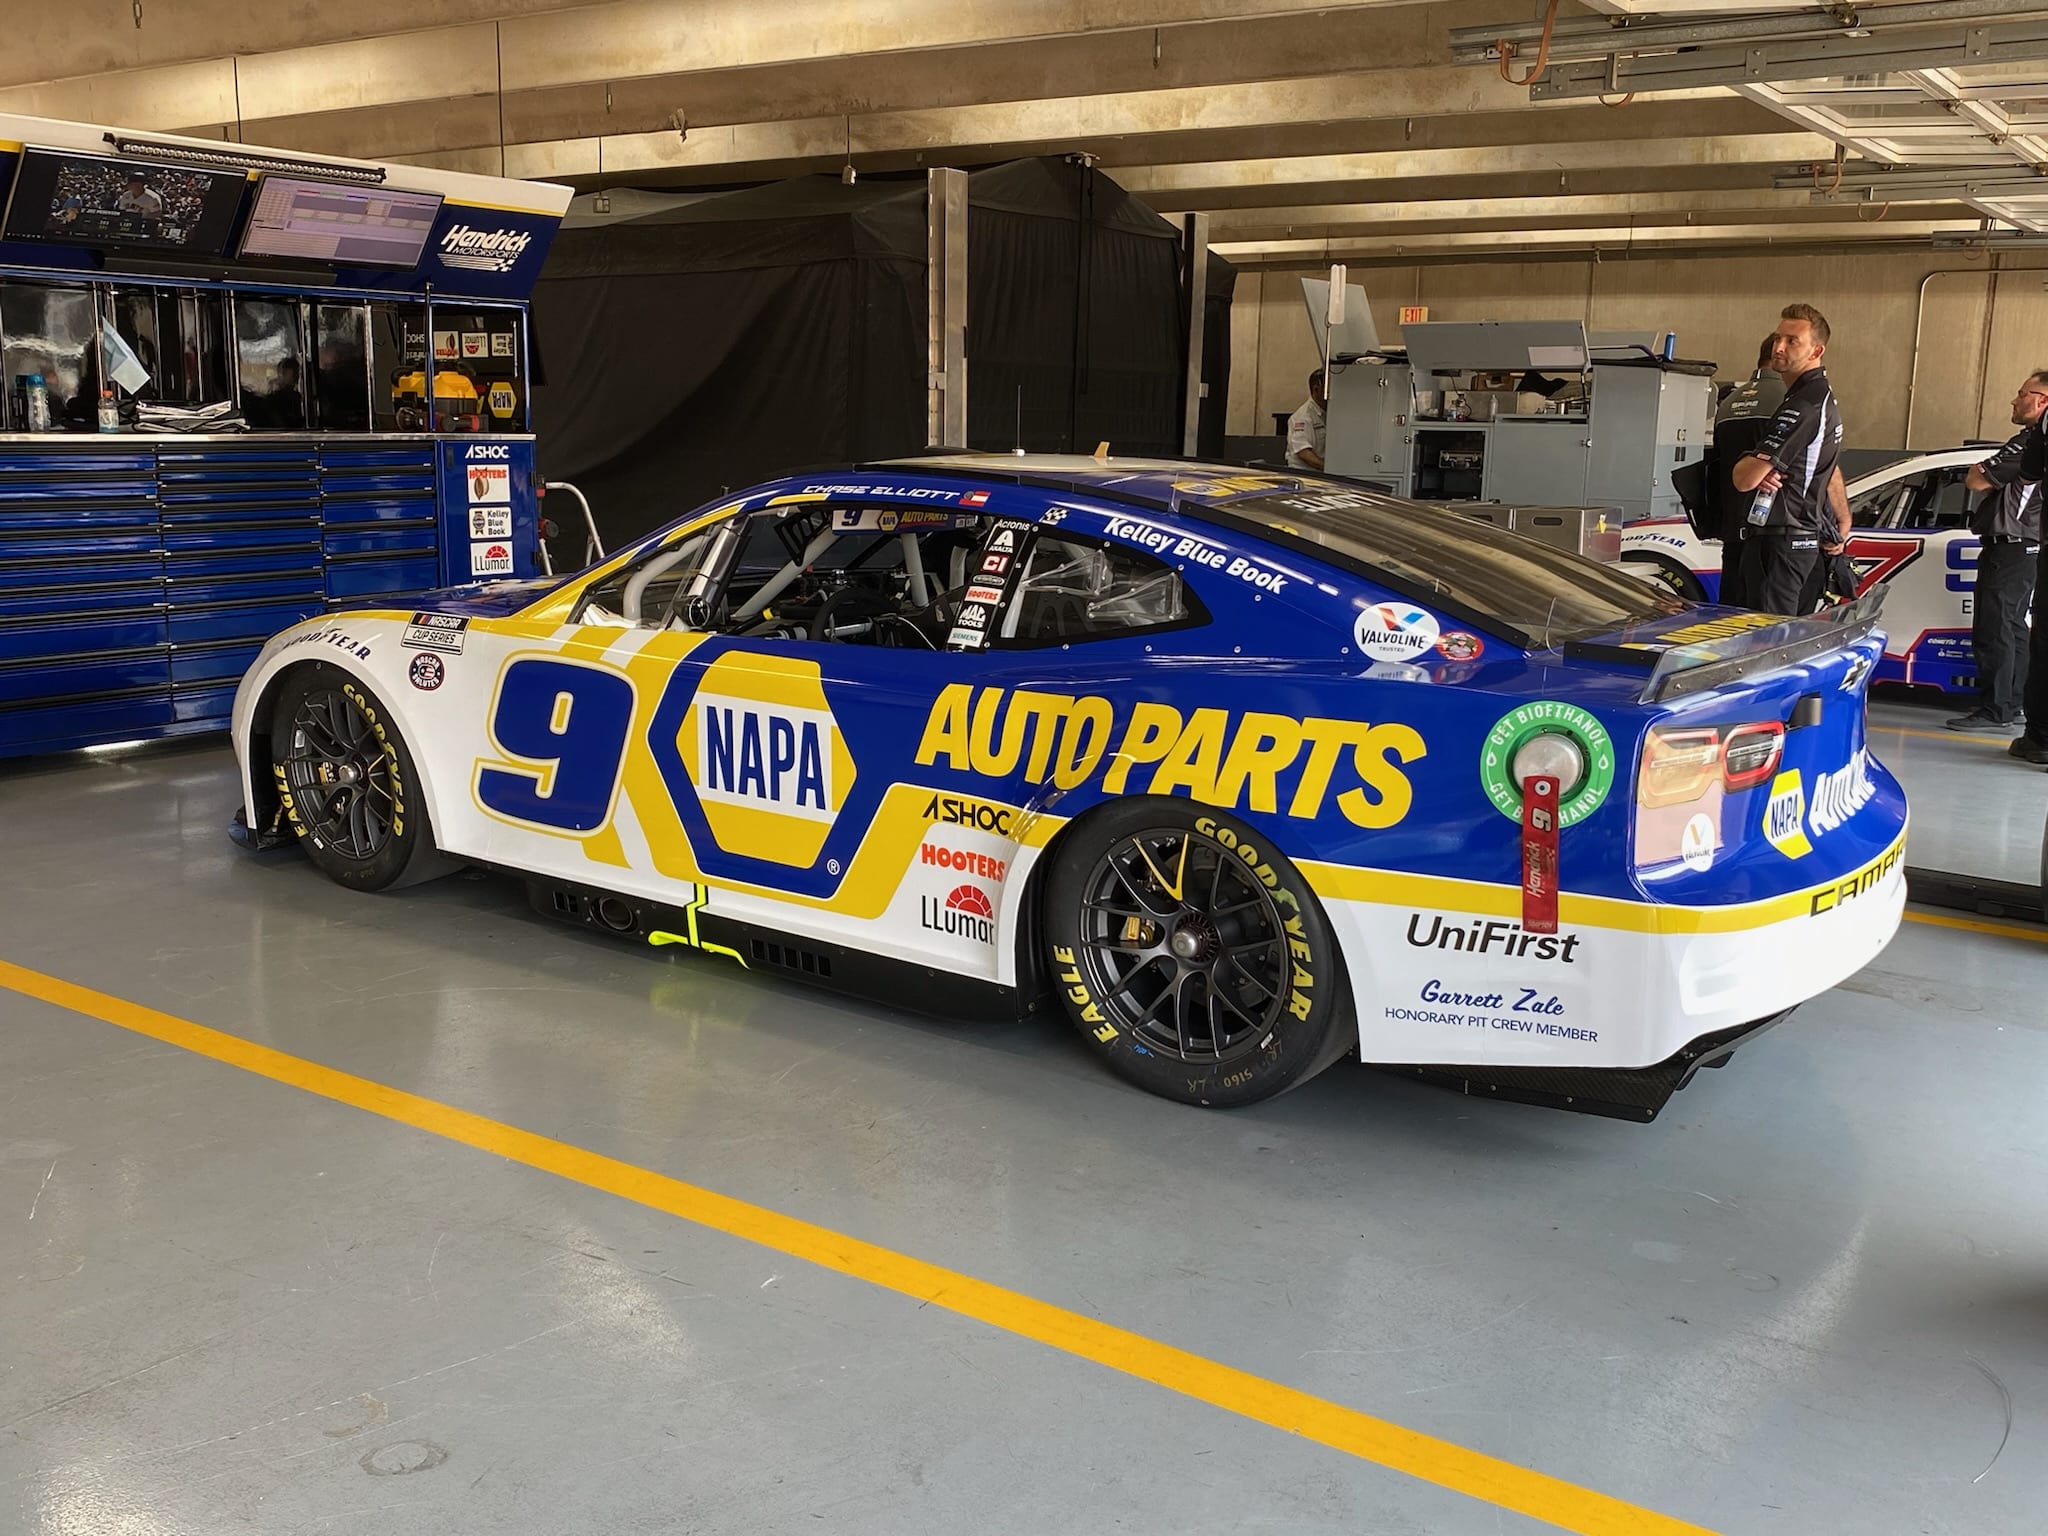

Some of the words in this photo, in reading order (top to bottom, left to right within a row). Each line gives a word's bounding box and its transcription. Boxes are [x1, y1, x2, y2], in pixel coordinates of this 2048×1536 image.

[441, 224, 532, 252] Hendrick
[453, 246, 520, 259] MOTORSPORTS
[1405, 308, 1422, 322] EXIT
[406, 334, 425, 343] SHOC
[492, 391, 513, 408] NAPA
[465, 444, 510, 459] ASHOC
[469, 468, 507, 479] HOOTERS
[802, 486, 871, 494] CHASE
[870, 487, 960, 500] ELLIOTT
[487, 510, 510, 518] Kelley
[488, 519, 504, 527] Blue
[901, 512, 925, 522] AUTO
[924, 512, 948, 521] PARTS
[996, 519, 1031, 531] Acronis
[488, 528, 506, 536] Book
[474, 556, 511, 572] LLumar
[1104, 517, 1176, 554] Kelley
[1173, 537, 1228, 569] Blue
[1226, 557, 1289, 594] Book
[968, 590, 998, 600] HOOTERS
[428, 616, 462, 628] NASCAR
[958, 619, 984, 628] TOOLS
[413, 630, 429, 640] CUP
[428, 632, 456, 644] SERIES
[1361, 628, 1427, 649] VALVOLINE
[416, 656, 440, 670] NASCAR
[1491, 721, 1516, 746] GET
[1517, 703, 1607, 752] BIOETHANOL
[471, 651, 637, 839] 9
[706, 705, 826, 810] NAPA
[915, 682, 1113, 790] AUTO
[1102, 702, 1427, 830] PARTS
[343, 683, 405, 837] GOODYEAR
[272, 763, 309, 838] EAGLE
[1489, 782, 1514, 809] GET
[1512, 786, 1604, 826] BHANOL
[1531, 807, 1553, 832] 9
[1770, 793, 1800, 840] NAPA
[921, 843, 1006, 882] HOOTERS
[1526, 841, 1545, 898] Hendrick
[1810, 838, 1906, 917] CAMAR
[922, 895, 994, 945] LLumar
[1194, 817, 1314, 1022] GOODYEAR
[1407, 914, 1580, 963] UniFirst
[1053, 944, 1119, 1043] EAGLE
[1420, 979, 1504, 1010] Garrett
[1512, 987, 1566, 1016] Zale
[1385, 1007, 1465, 1026] HONORARY
[1468, 1015, 1488, 1028] PIT
[1491, 1018, 1534, 1034] CREW
[1536, 1022, 1598, 1042] MEMBER
